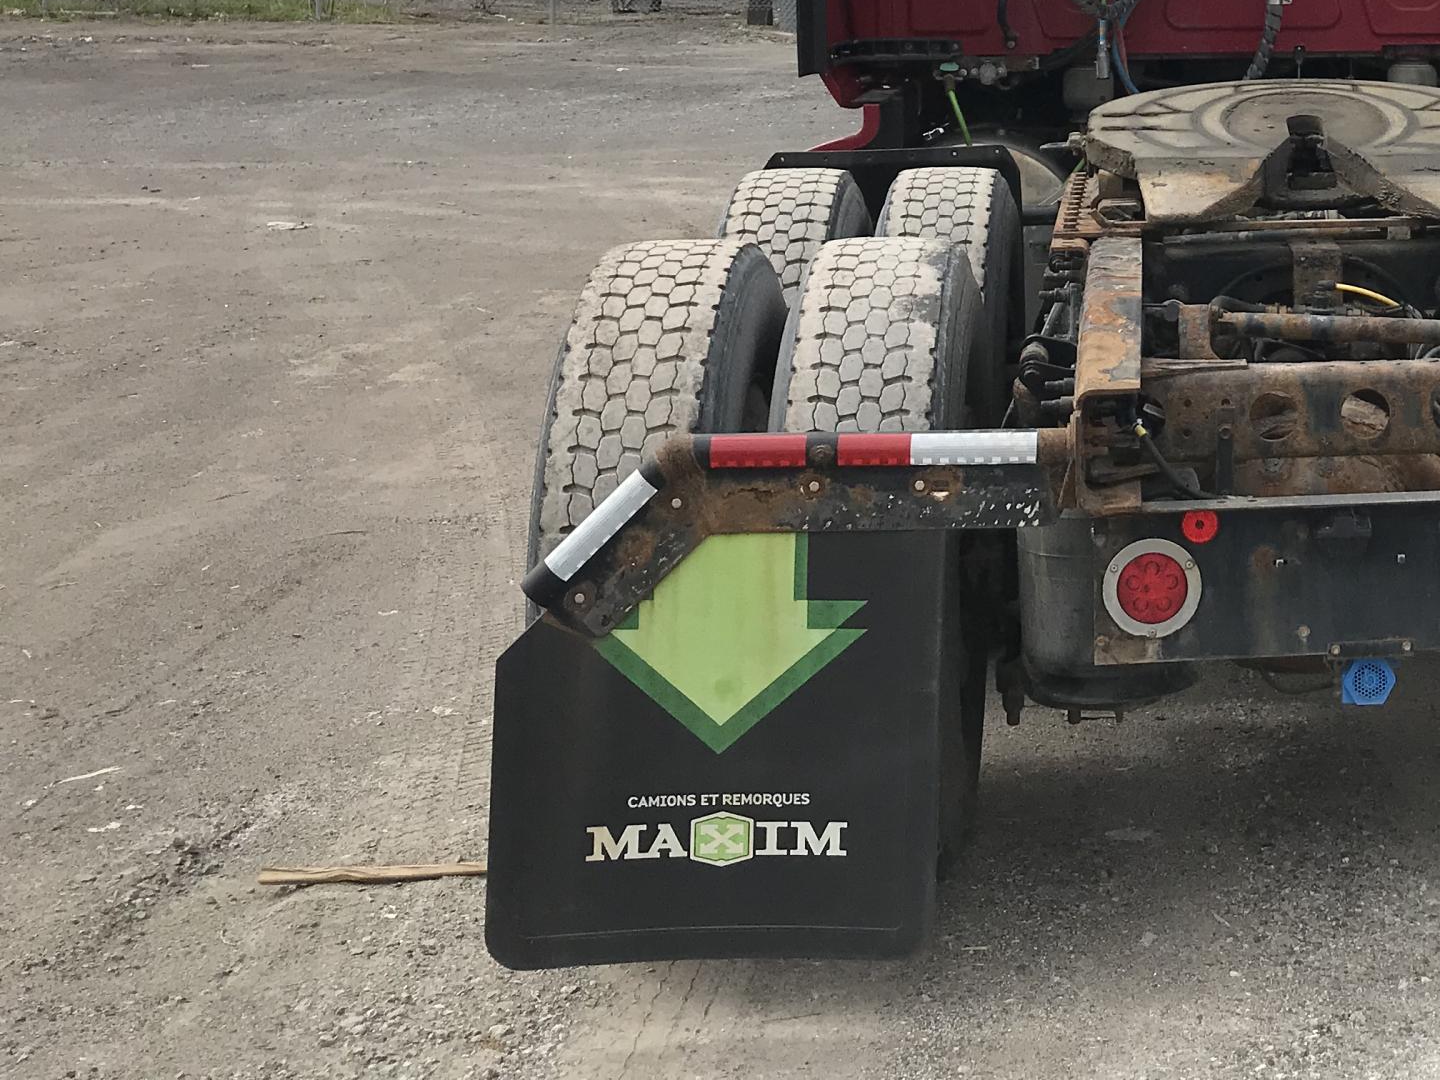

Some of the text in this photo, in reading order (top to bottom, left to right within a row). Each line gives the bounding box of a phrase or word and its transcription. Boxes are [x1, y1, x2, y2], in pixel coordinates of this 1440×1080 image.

[627, 792, 811, 809] CAMIONS ET REMORQUES
[585, 811, 848, 866] MAXIM
